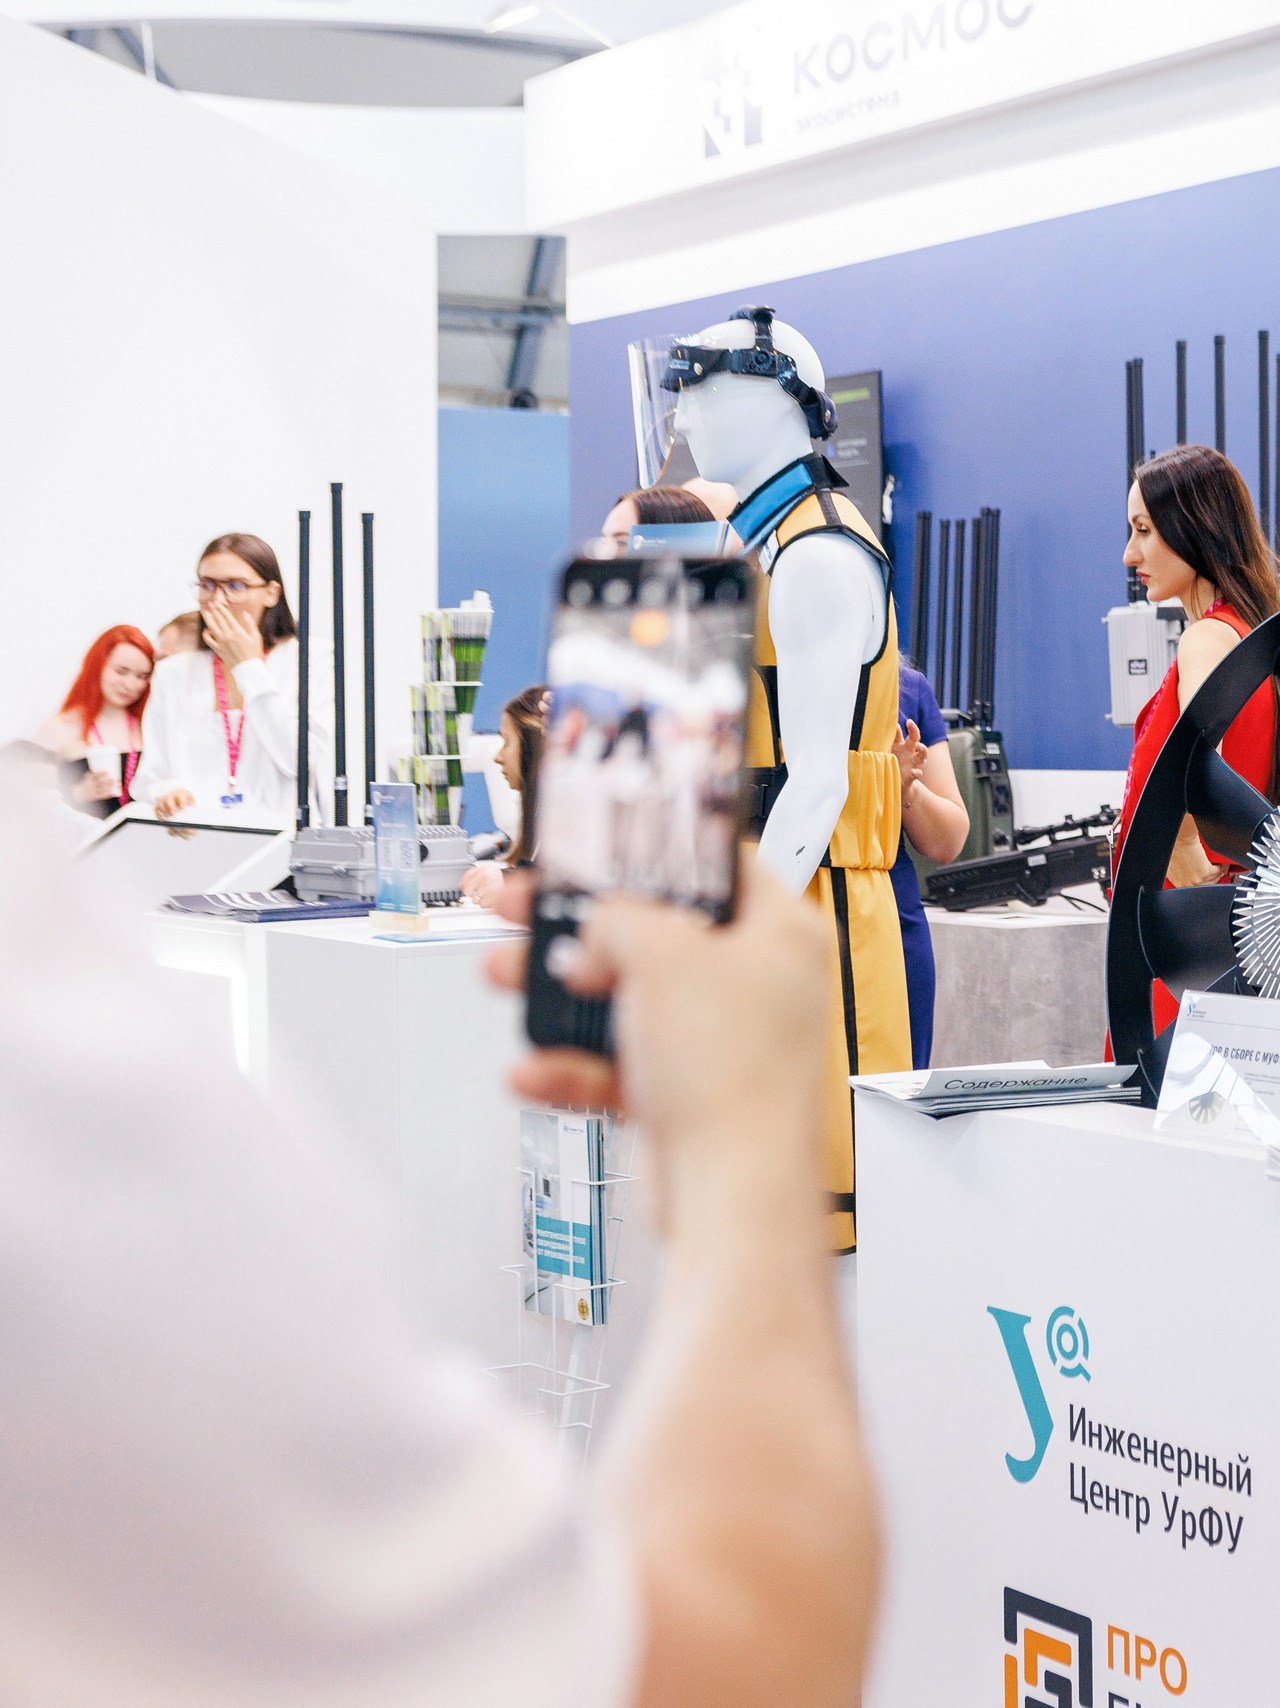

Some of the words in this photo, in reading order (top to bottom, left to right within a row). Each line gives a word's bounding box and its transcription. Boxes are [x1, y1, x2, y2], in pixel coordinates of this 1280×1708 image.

[793, 0, 1034, 94] КОСМОС
[943, 1075, 1089, 1092] Содержание
[1223, 1048, 1229, 1059] В
[1230, 1048, 1254, 1061] СБОРЕ
[1255, 1051, 1261, 1063] С
[1068, 1403, 1253, 1498] Инженерный
[1068, 1462, 1152, 1534] Центр
[1160, 1490, 1245, 1554] УрФУ
[1107, 1624, 1188, 1697] ПРО
